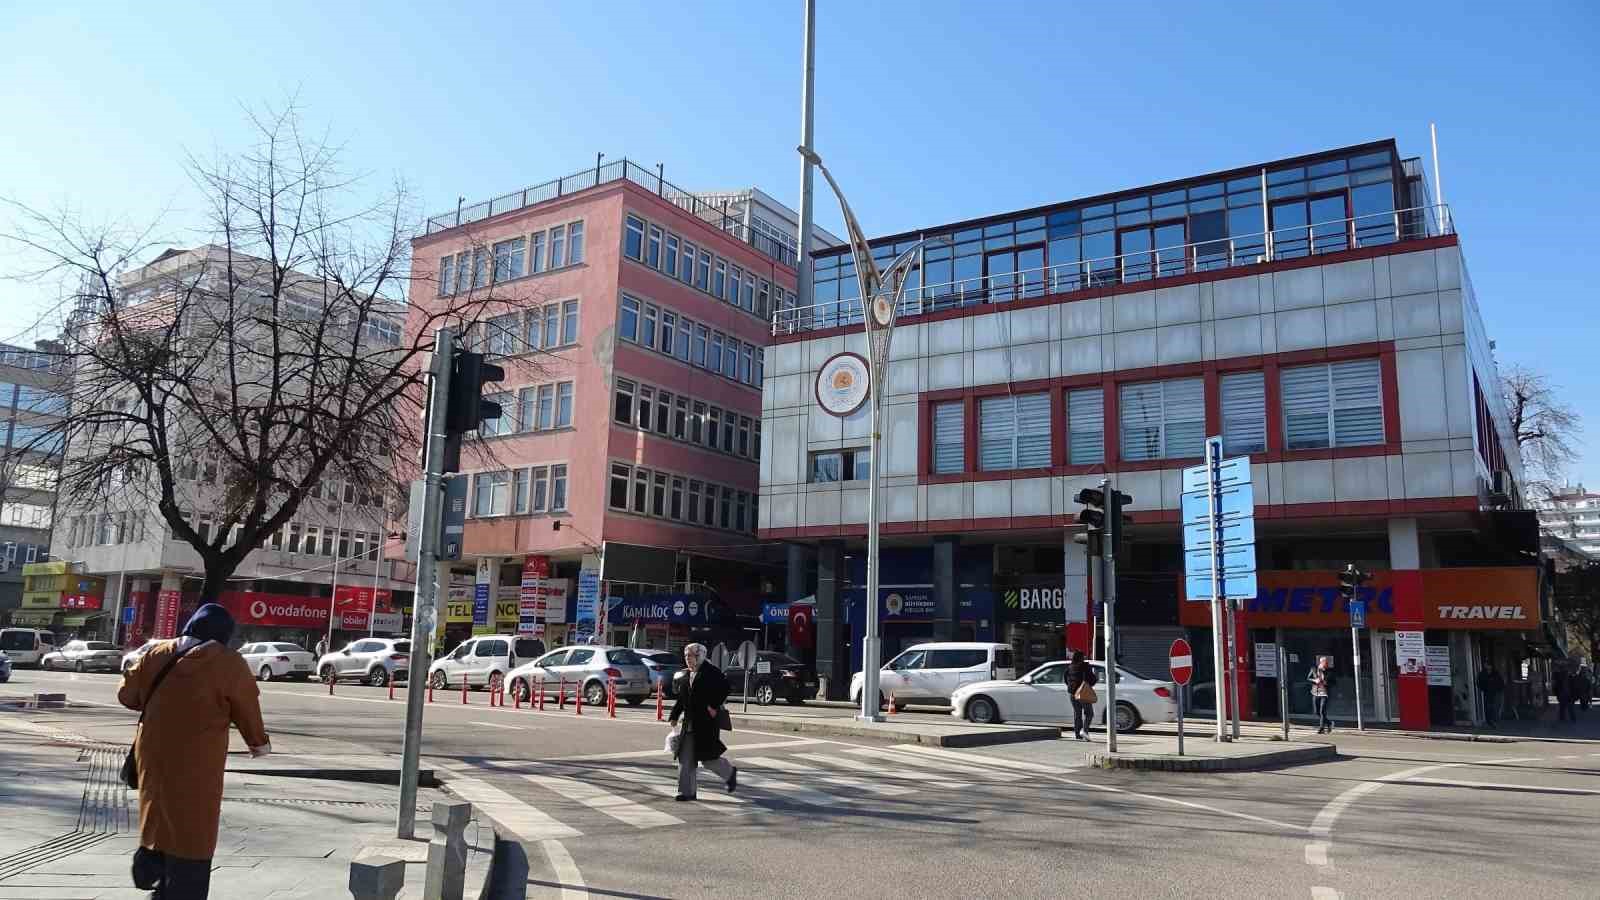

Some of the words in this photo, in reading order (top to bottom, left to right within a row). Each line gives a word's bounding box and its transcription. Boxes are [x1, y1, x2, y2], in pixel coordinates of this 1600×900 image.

[1020, 588, 1066, 609] BARG
[268, 604, 328, 619] vodafone
[1438, 606, 1527, 619] TRAVEL
